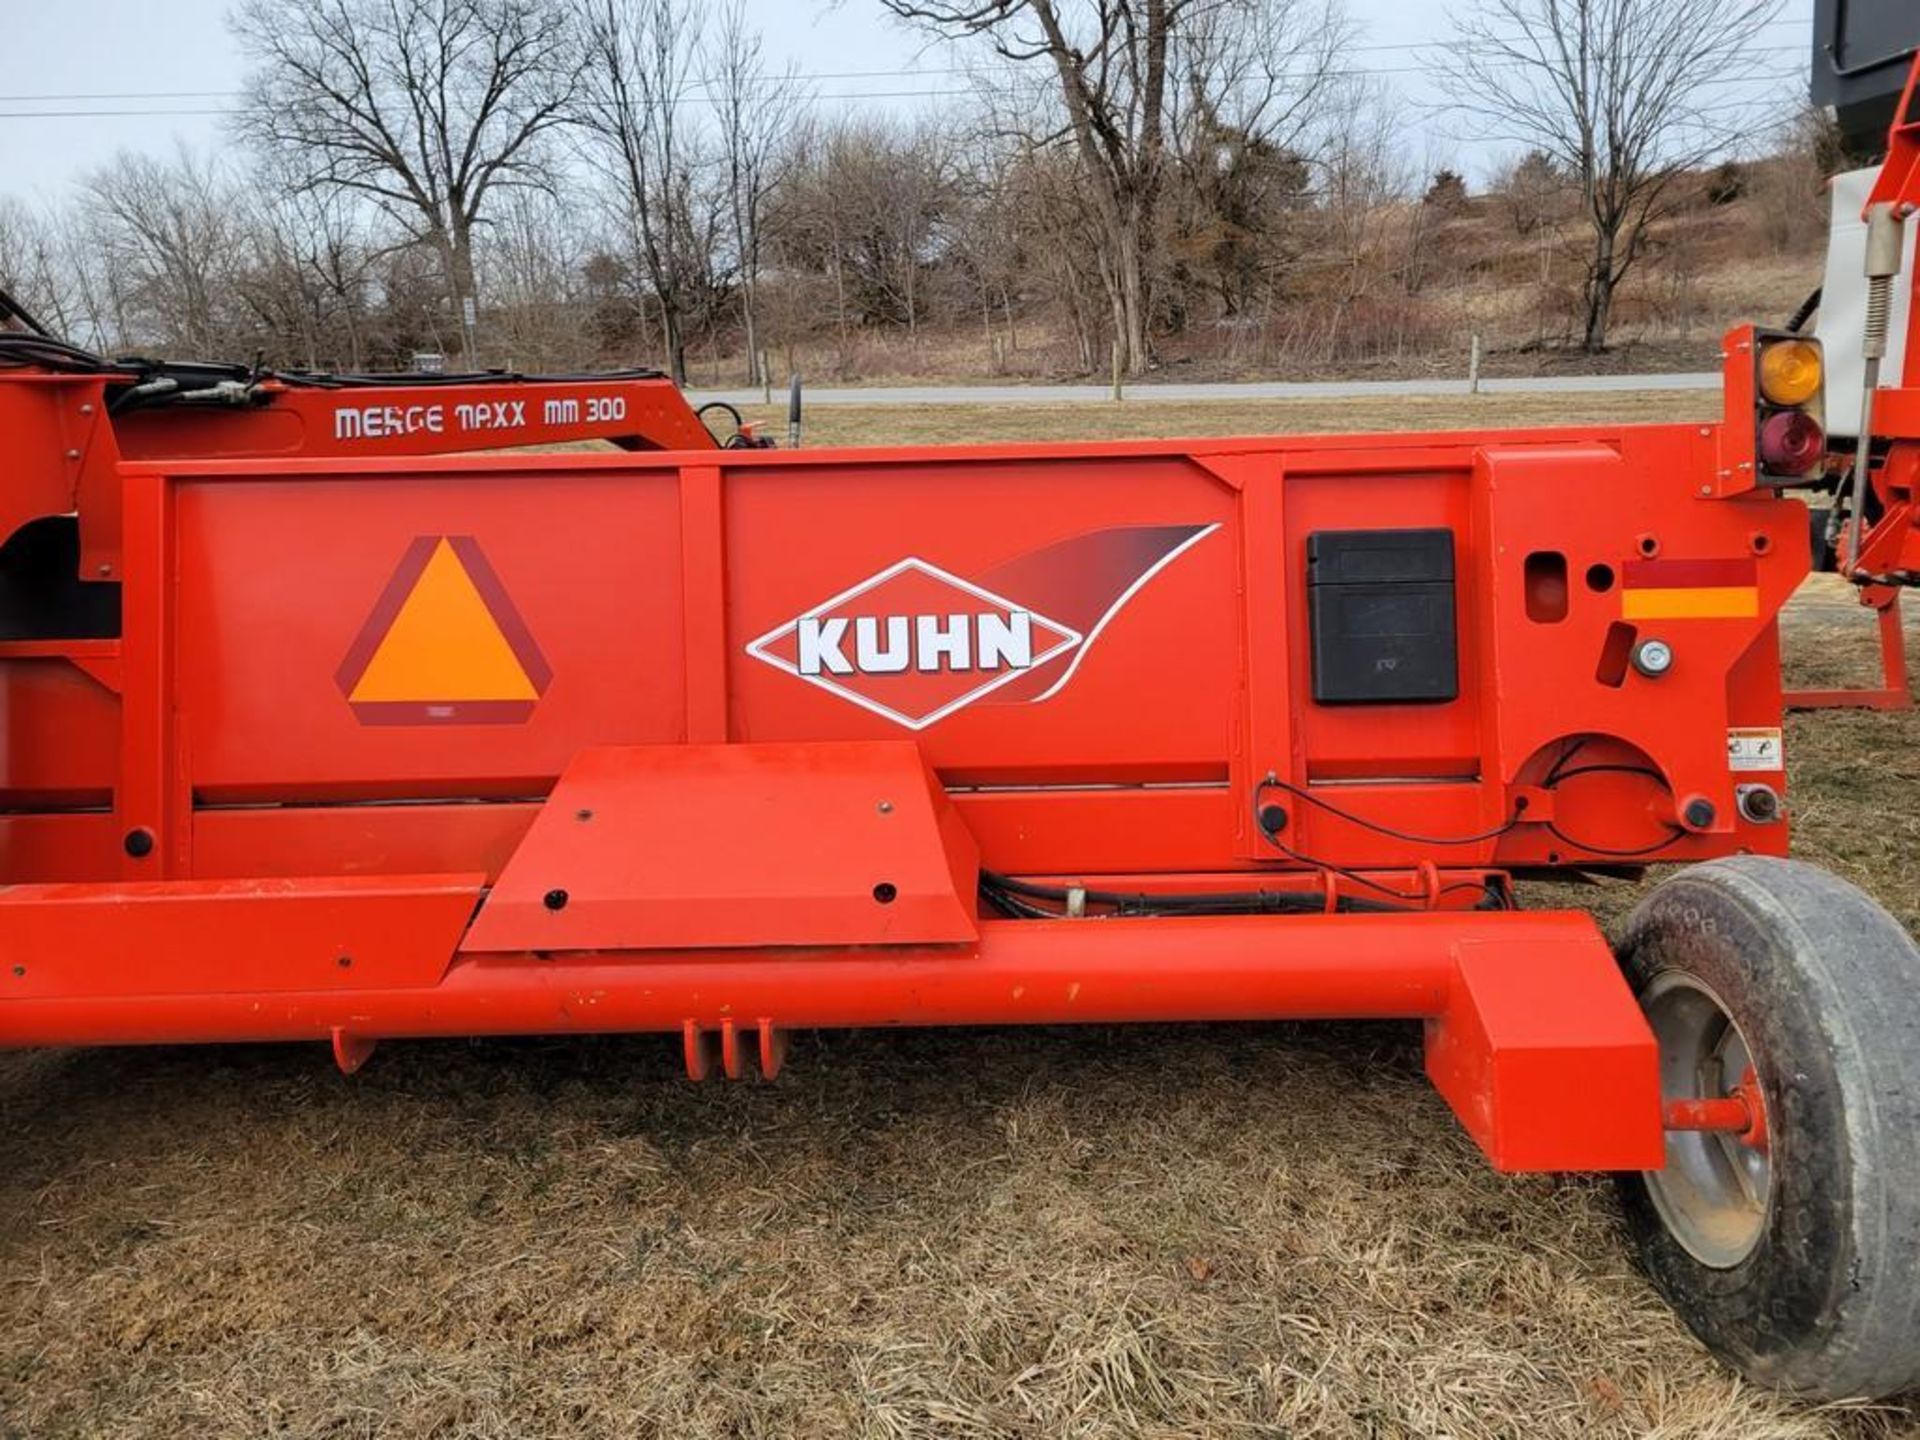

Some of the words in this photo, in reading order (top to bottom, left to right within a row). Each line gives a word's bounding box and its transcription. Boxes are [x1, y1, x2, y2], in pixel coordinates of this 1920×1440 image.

[335, 405, 443, 439] MERGE
[586, 397, 626, 422] 300
[797, 611, 1031, 675] KUHN
